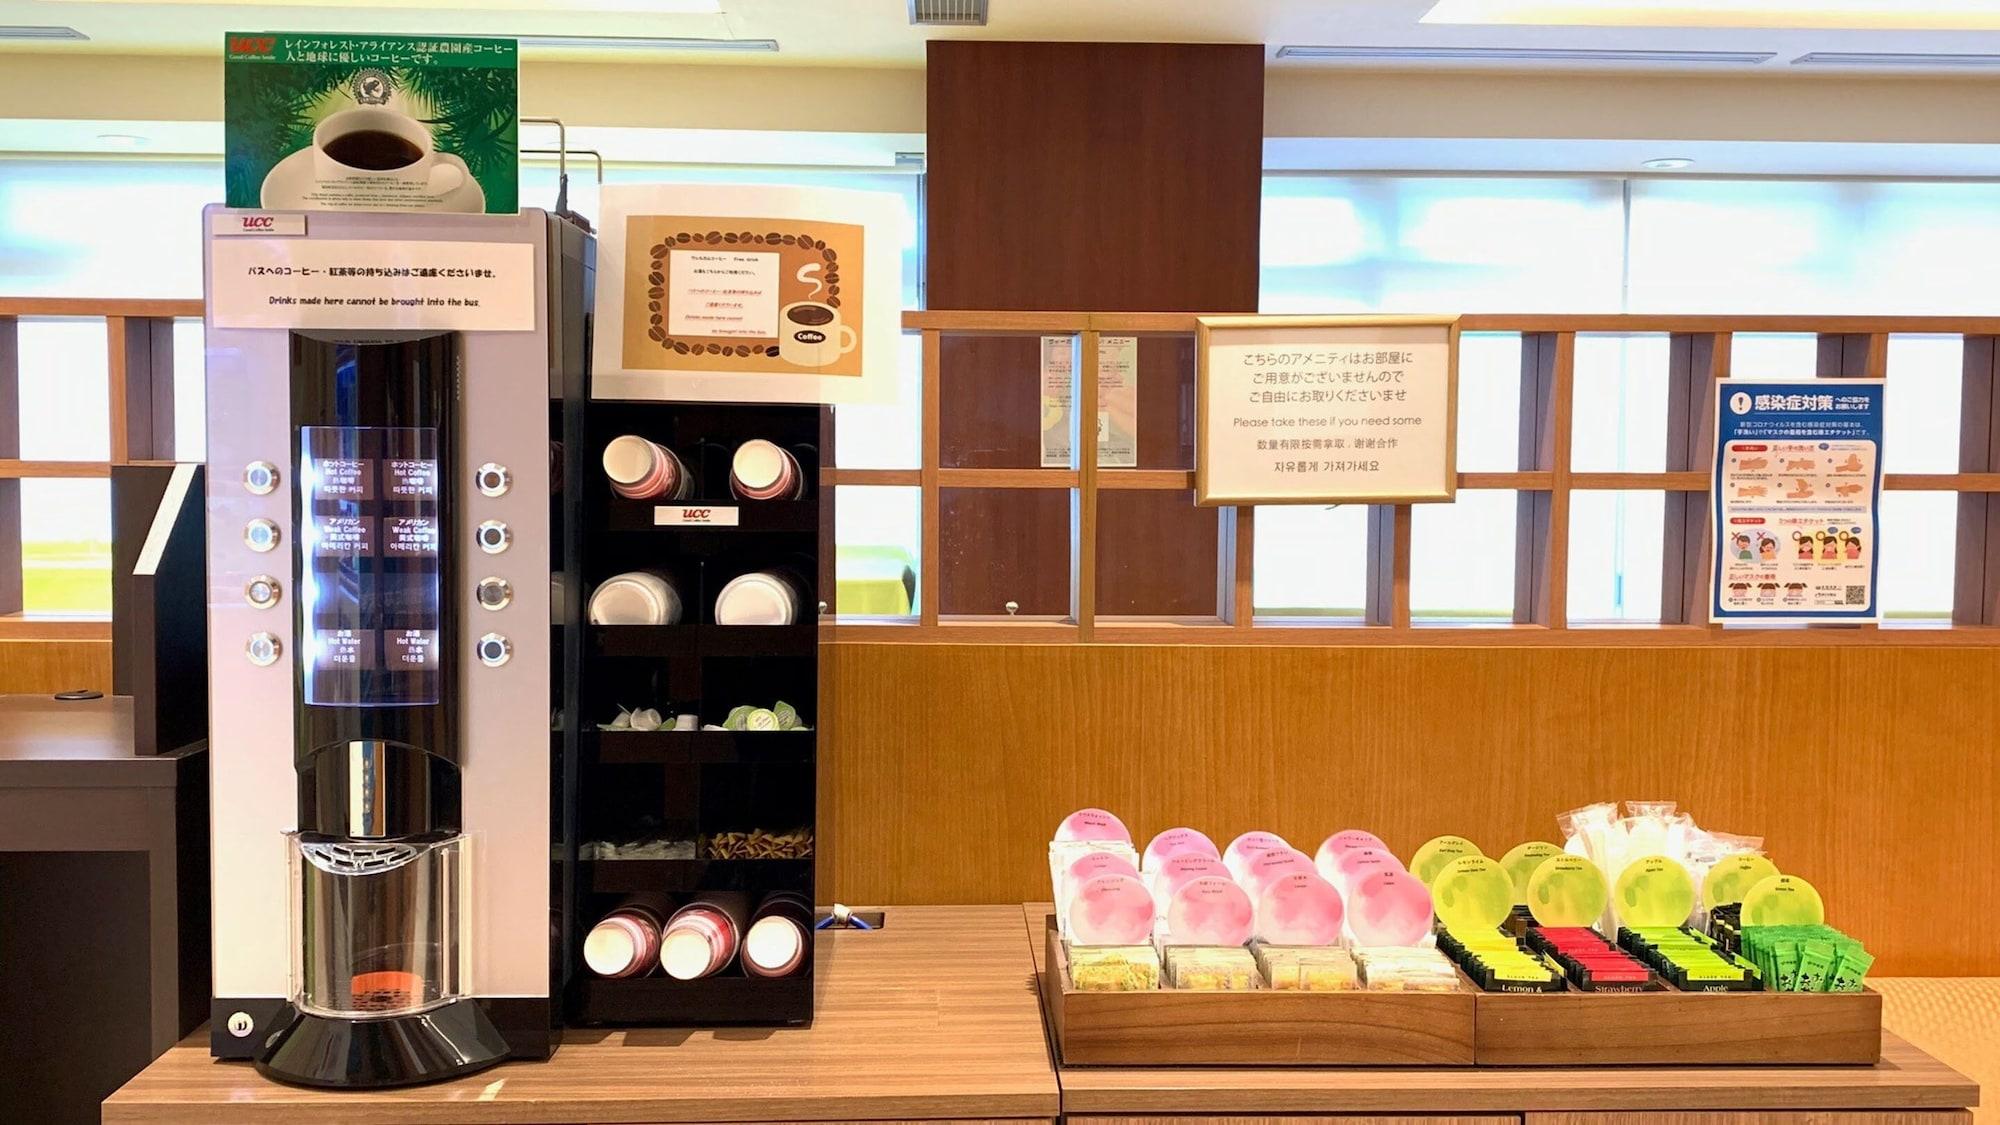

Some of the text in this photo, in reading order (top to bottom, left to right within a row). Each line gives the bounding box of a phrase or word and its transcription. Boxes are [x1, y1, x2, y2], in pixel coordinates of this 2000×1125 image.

[286, 50, 439, 65] 人と地球に優しいコーヒーです。
[269, 296, 297, 305] Drinks
[300, 297, 321, 305] made
[324, 297, 344, 305] here
[347, 297, 376, 305] cannot
[379, 297, 388, 305] be
[391, 297, 424, 306] brought
[427, 297, 445, 306] into
[448, 297, 461, 306] the
[797, 333, 823, 341] Coffee
[1243, 351, 1413, 366] こちらのアメニティはお部屋に
[1252, 370, 1404, 385] ご用意がございませんので
[1249, 388, 1407, 404] ご自由にお取りくださいませ
[1755, 395, 1833, 411] 感染症対策
[1233, 416, 1422, 429] Please take these if you need some
[1274, 460, 1379, 473] 자유롭게 가져가세요
[323, 526, 367, 534] Weak Coffee
[392, 526, 436, 534] Weak Coffee
[1501, 984, 1534, 993] Lemon
[1595, 985, 1643, 993] Strawberry
[1703, 984, 1729, 992] Apple
